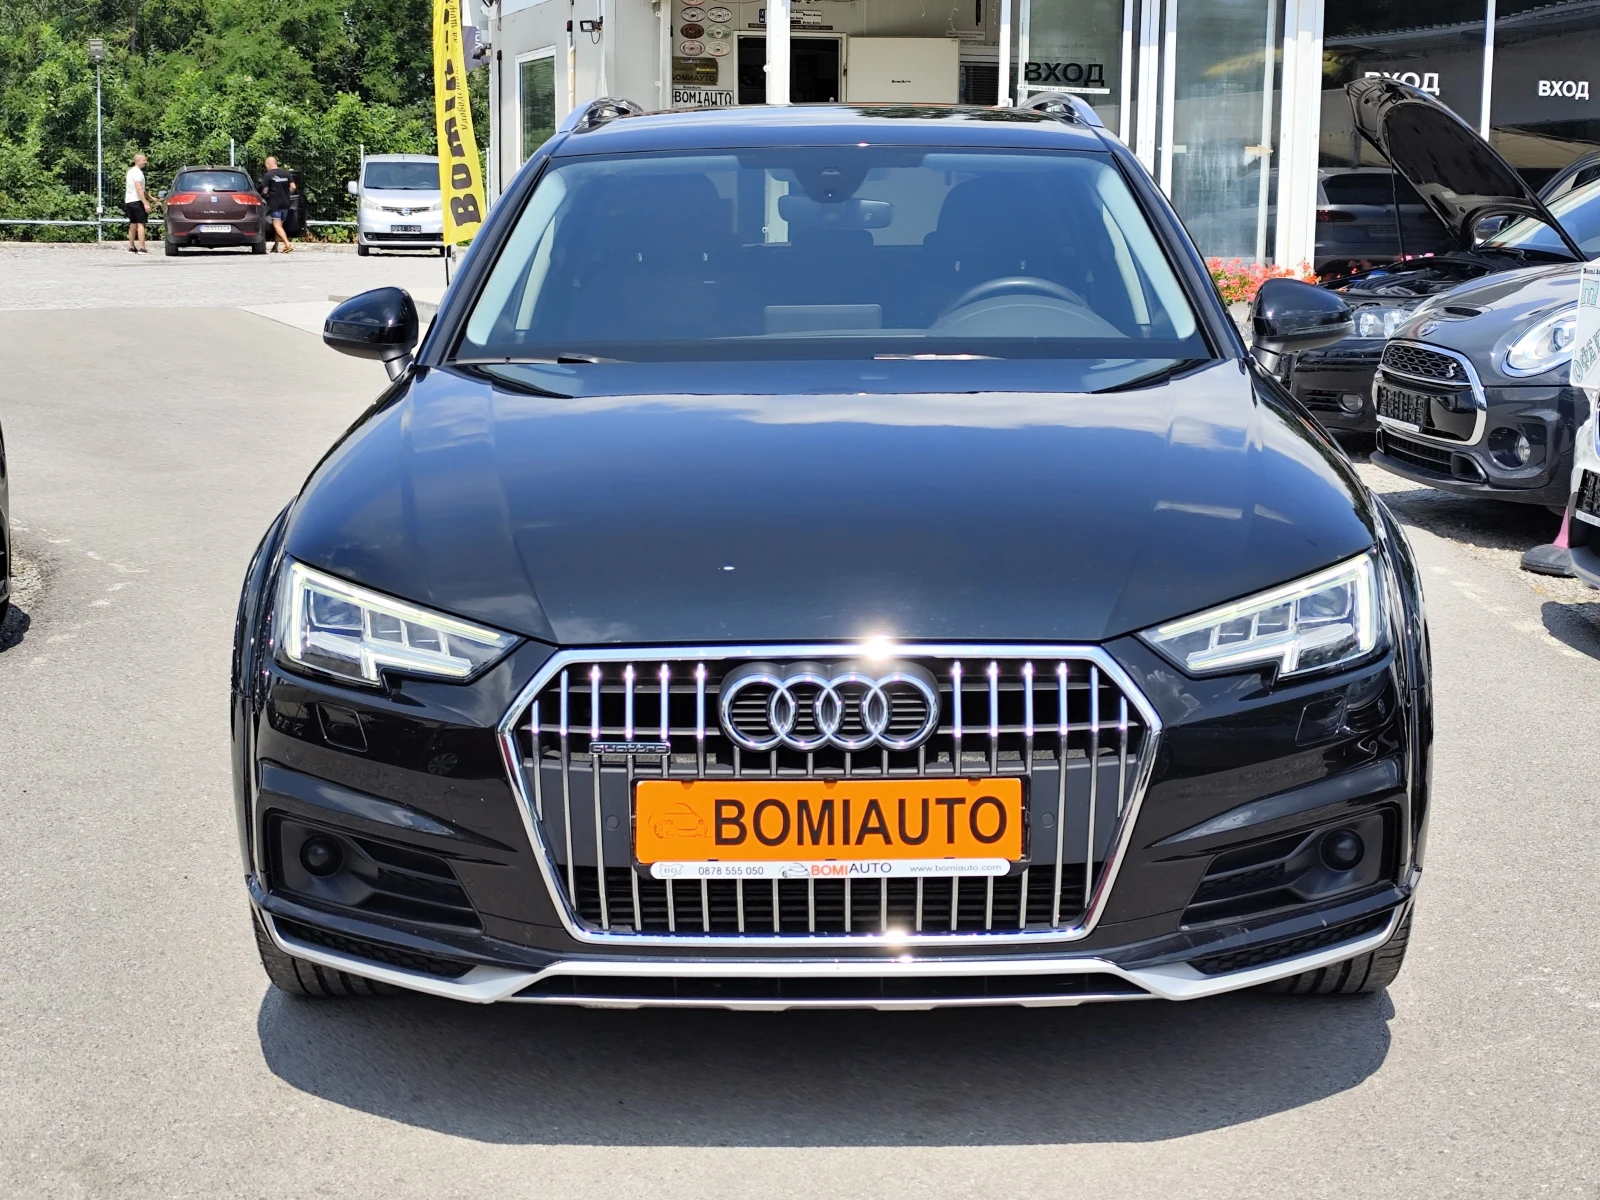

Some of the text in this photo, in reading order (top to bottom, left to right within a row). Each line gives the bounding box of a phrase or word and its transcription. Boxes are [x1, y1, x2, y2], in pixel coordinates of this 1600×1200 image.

[1024, 62, 1105, 87] ВХОД
[1538, 80, 1589, 100] ВХОД
[593, 743, 667, 754] quattro
[714, 796, 1007, 846] BOMIAUTO
[698, 866, 764, 876] 0878 555 050
[909, 863, 1002, 873] www.bomiauto.com
